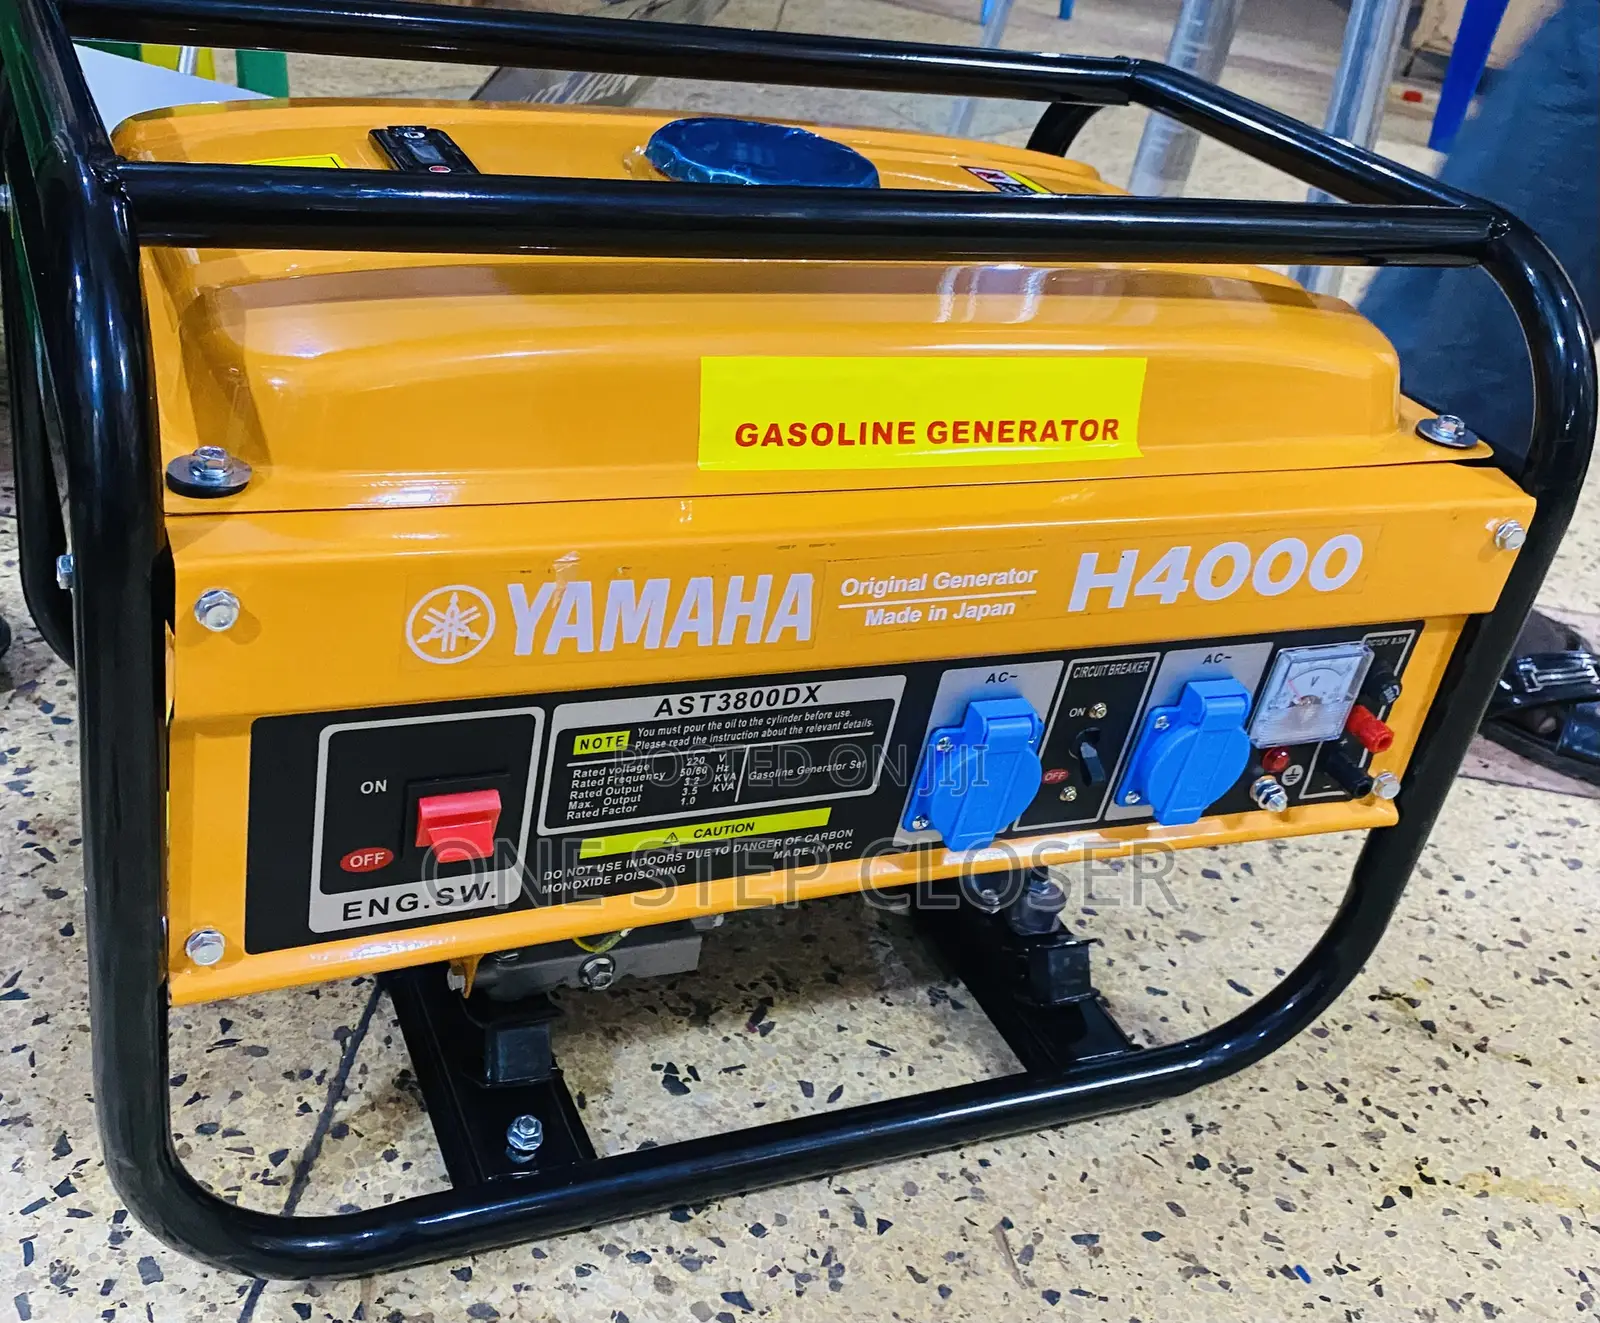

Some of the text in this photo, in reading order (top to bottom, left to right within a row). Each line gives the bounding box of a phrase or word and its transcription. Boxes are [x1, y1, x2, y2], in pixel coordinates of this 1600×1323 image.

[734, 418, 1120, 447] GASOLINE GENERATOR
[840, 568, 1038, 598] Original Generator
[1067, 533, 1364, 612] H4000
[507, 573, 815, 656] YAMAHA
[864, 601, 1016, 627] Made in Japan
[1072, 660, 1150, 679] CIRCUIT BREAKER
[653, 684, 823, 718] AST3800DX
[1069, 707, 1087, 718] ON
[635, 718, 874, 751] Please read the instruction about the relevant details.
[637, 709, 853, 738] You must pour the oil to the cylinder before use.
[580, 735, 625, 751] NOTE
[571, 763, 730, 789] Rated Frequency 50/60 Hz
[573, 753, 727, 779] Rated voltage 220 V
[749, 759, 866, 781] Gasoline Generator Set
[1044, 771, 1067, 782] OFF
[360, 779, 387, 795] ON
[568, 782, 736, 811] Max. Output 3.5 KVA
[570, 788, 603, 800] Rated
[605, 784, 644, 797] Output
[714, 772, 737, 782] KVA
[566, 796, 696, 820] Rated Factor 1.0
[693, 822, 755, 839] CAUTION
[349, 851, 385, 868] OFF
[543, 828, 854, 881] DO NOT USE INDOORS DUE TO DANGER OF CARBON
[773, 841, 853, 860] MADE IN PRC
[541, 864, 686, 895] MONOXIDE POISONING
